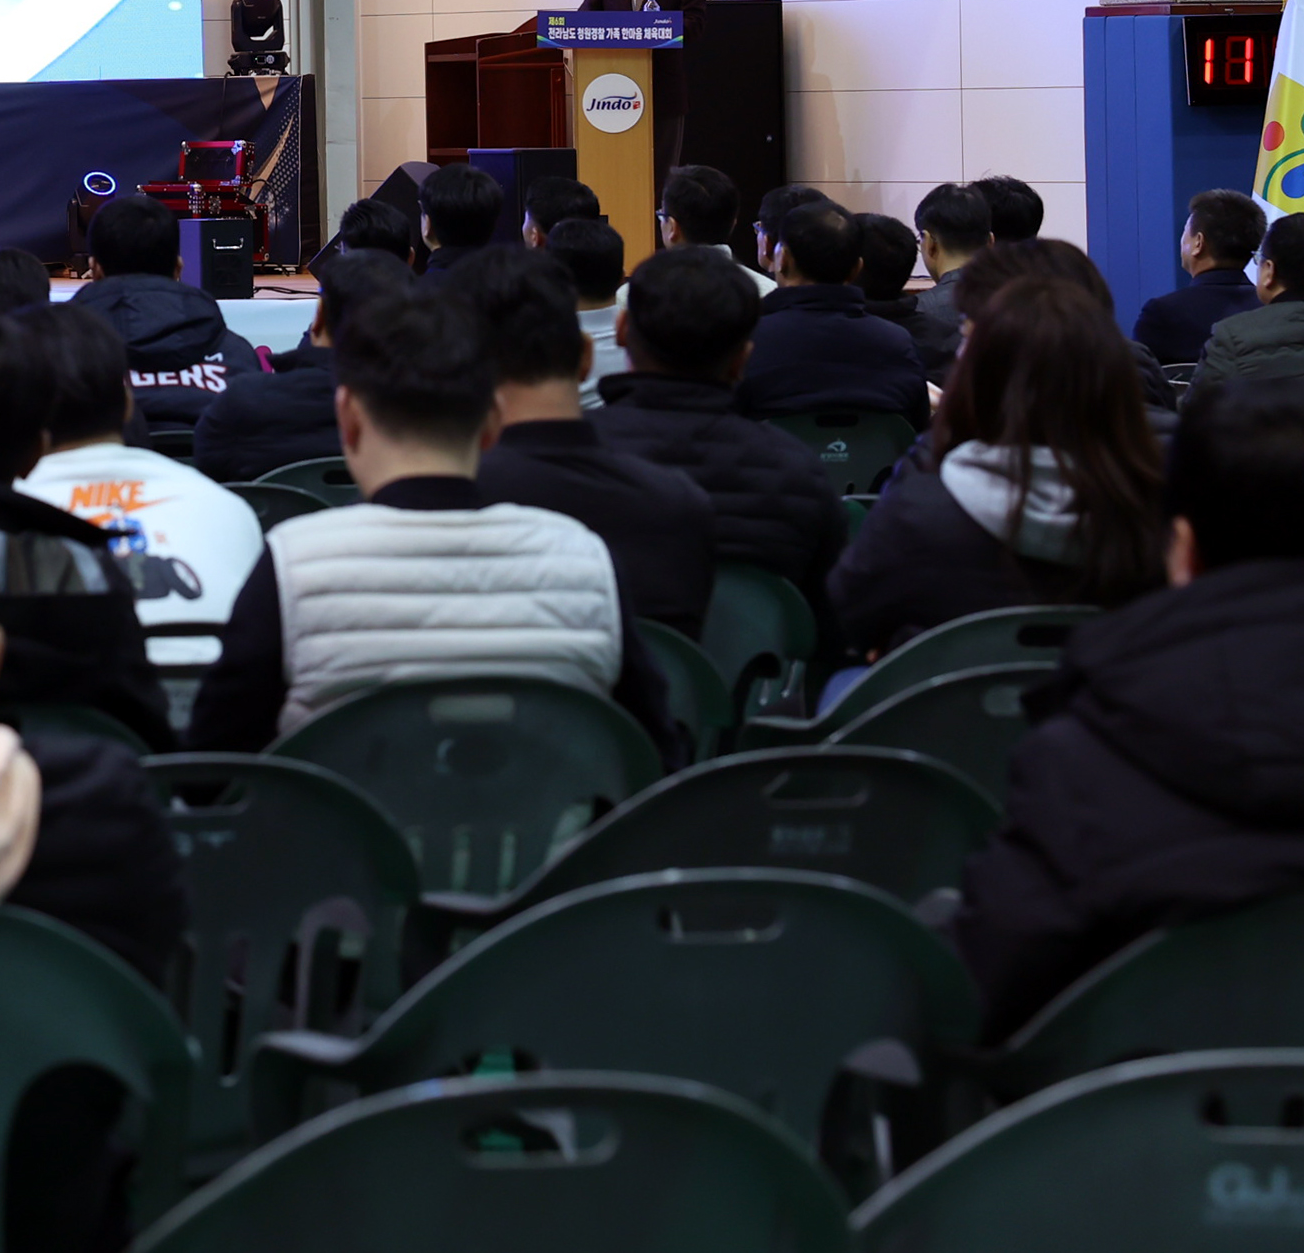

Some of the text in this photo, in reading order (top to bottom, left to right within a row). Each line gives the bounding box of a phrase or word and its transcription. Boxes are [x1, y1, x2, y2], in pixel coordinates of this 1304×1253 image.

[548, 16, 565, 26] 제6회
[548, 27, 672, 41] 전라남도 청원경찰 가족 한마음 체육대회
[586, 98, 632, 112] Jindo
[124, 364, 228, 393] GERS
[69, 480, 146, 513] NIKE
